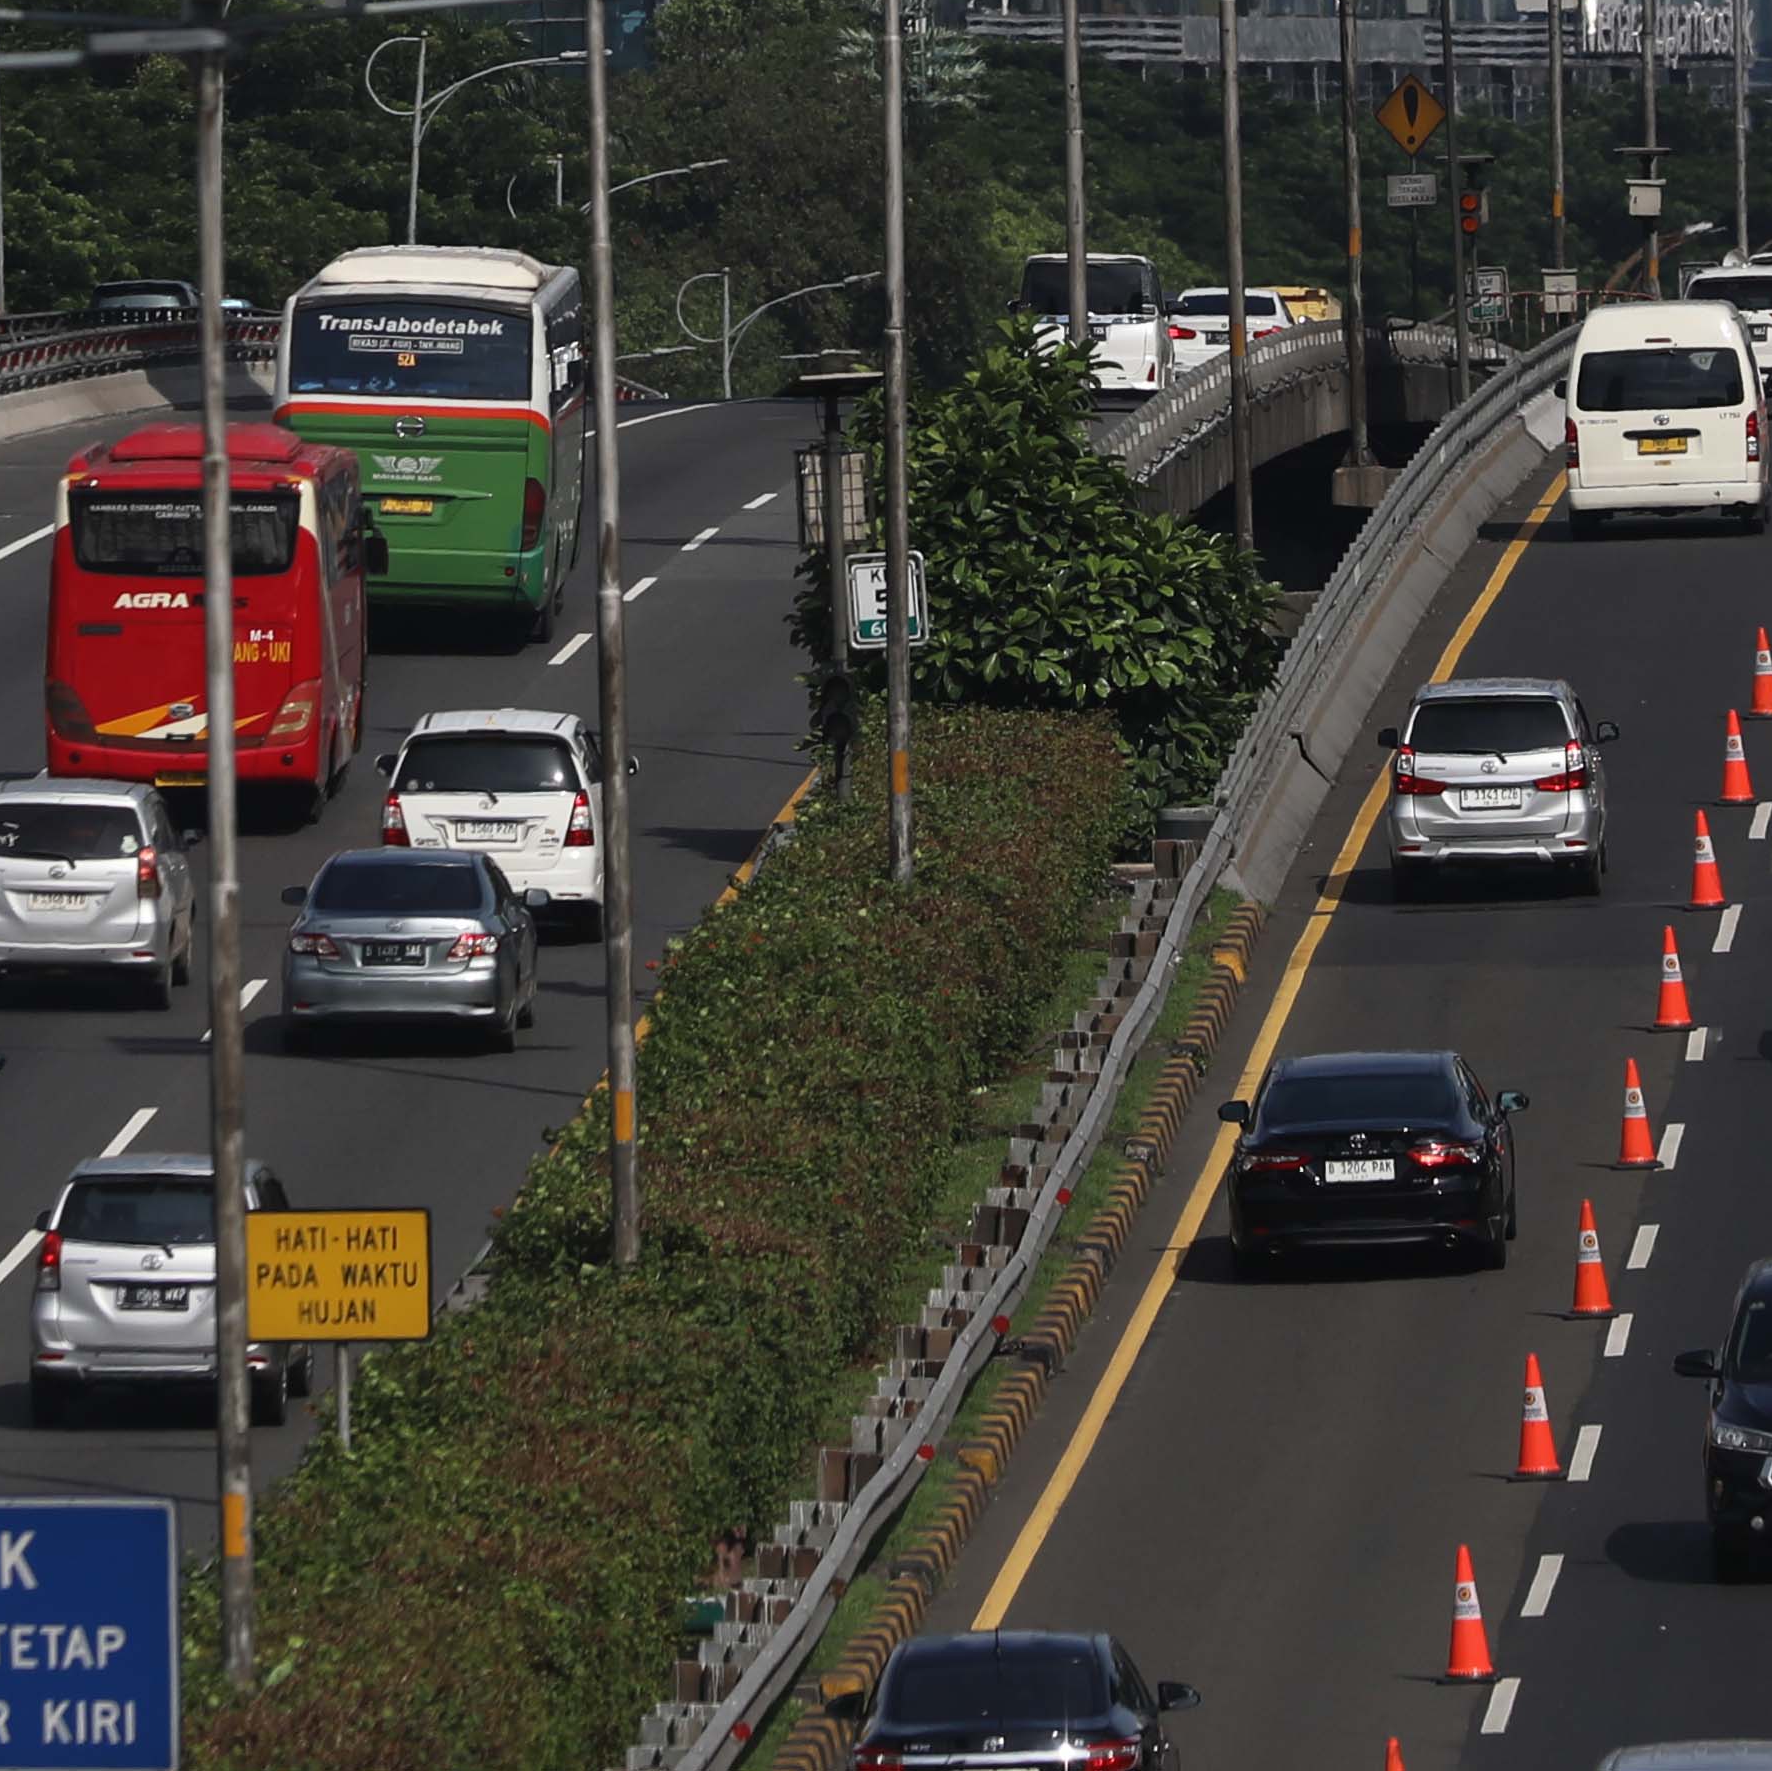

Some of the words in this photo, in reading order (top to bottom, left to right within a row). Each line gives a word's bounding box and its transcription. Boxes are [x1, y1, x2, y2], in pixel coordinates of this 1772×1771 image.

[318, 314, 503, 336] TransJabodetabek
[113, 592, 189, 610] AGRA
[249, 629, 274, 641] M-4
[268, 640, 291, 661] UKI
[256, 1263, 318, 1288] PADA
[341, 1262, 419, 1288] WAKTU
[297, 1299, 376, 1325] HUJAN
[42, 1700, 137, 1746] KIRI
